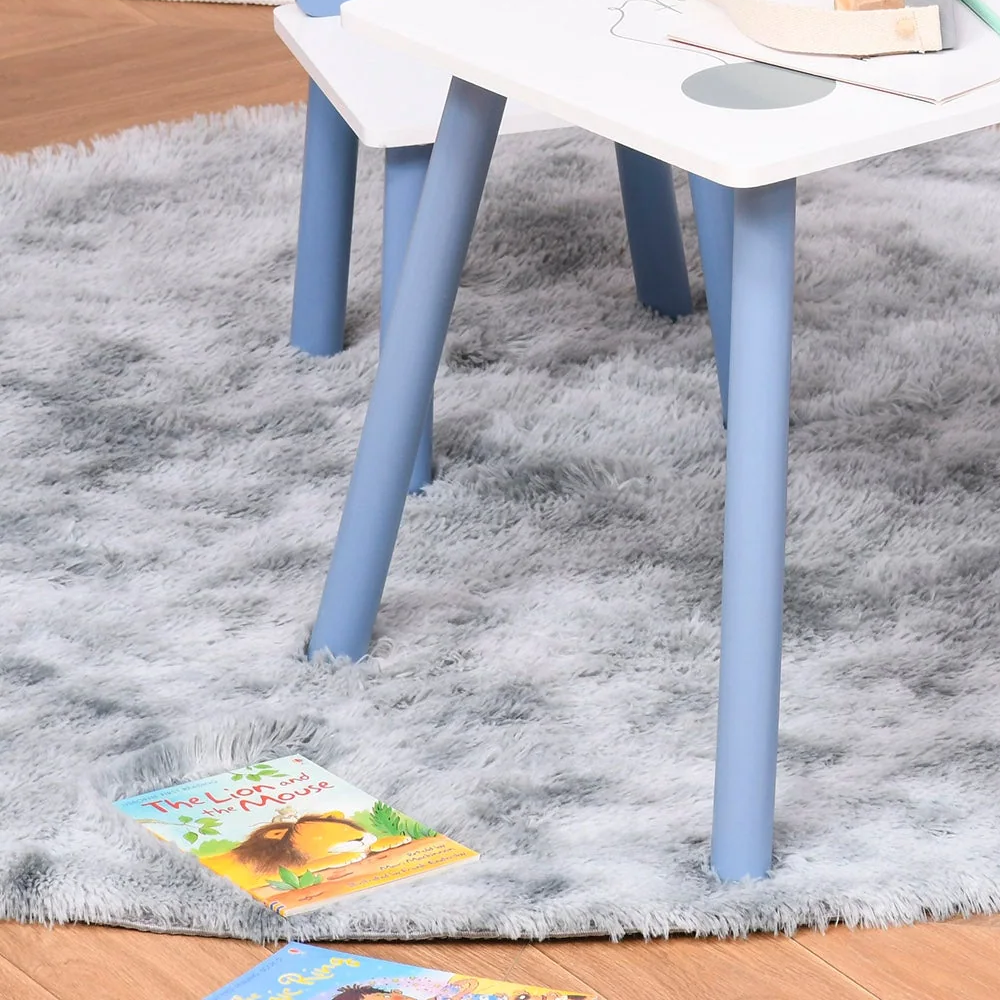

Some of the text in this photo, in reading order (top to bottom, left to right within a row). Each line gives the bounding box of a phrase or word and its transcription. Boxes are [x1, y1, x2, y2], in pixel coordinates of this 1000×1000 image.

[141, 795, 206, 814] The
[204, 782, 276, 804] Lion
[279, 772, 311, 787] and
[202, 805, 236, 817] the
[239, 780, 335, 813] Mouse
